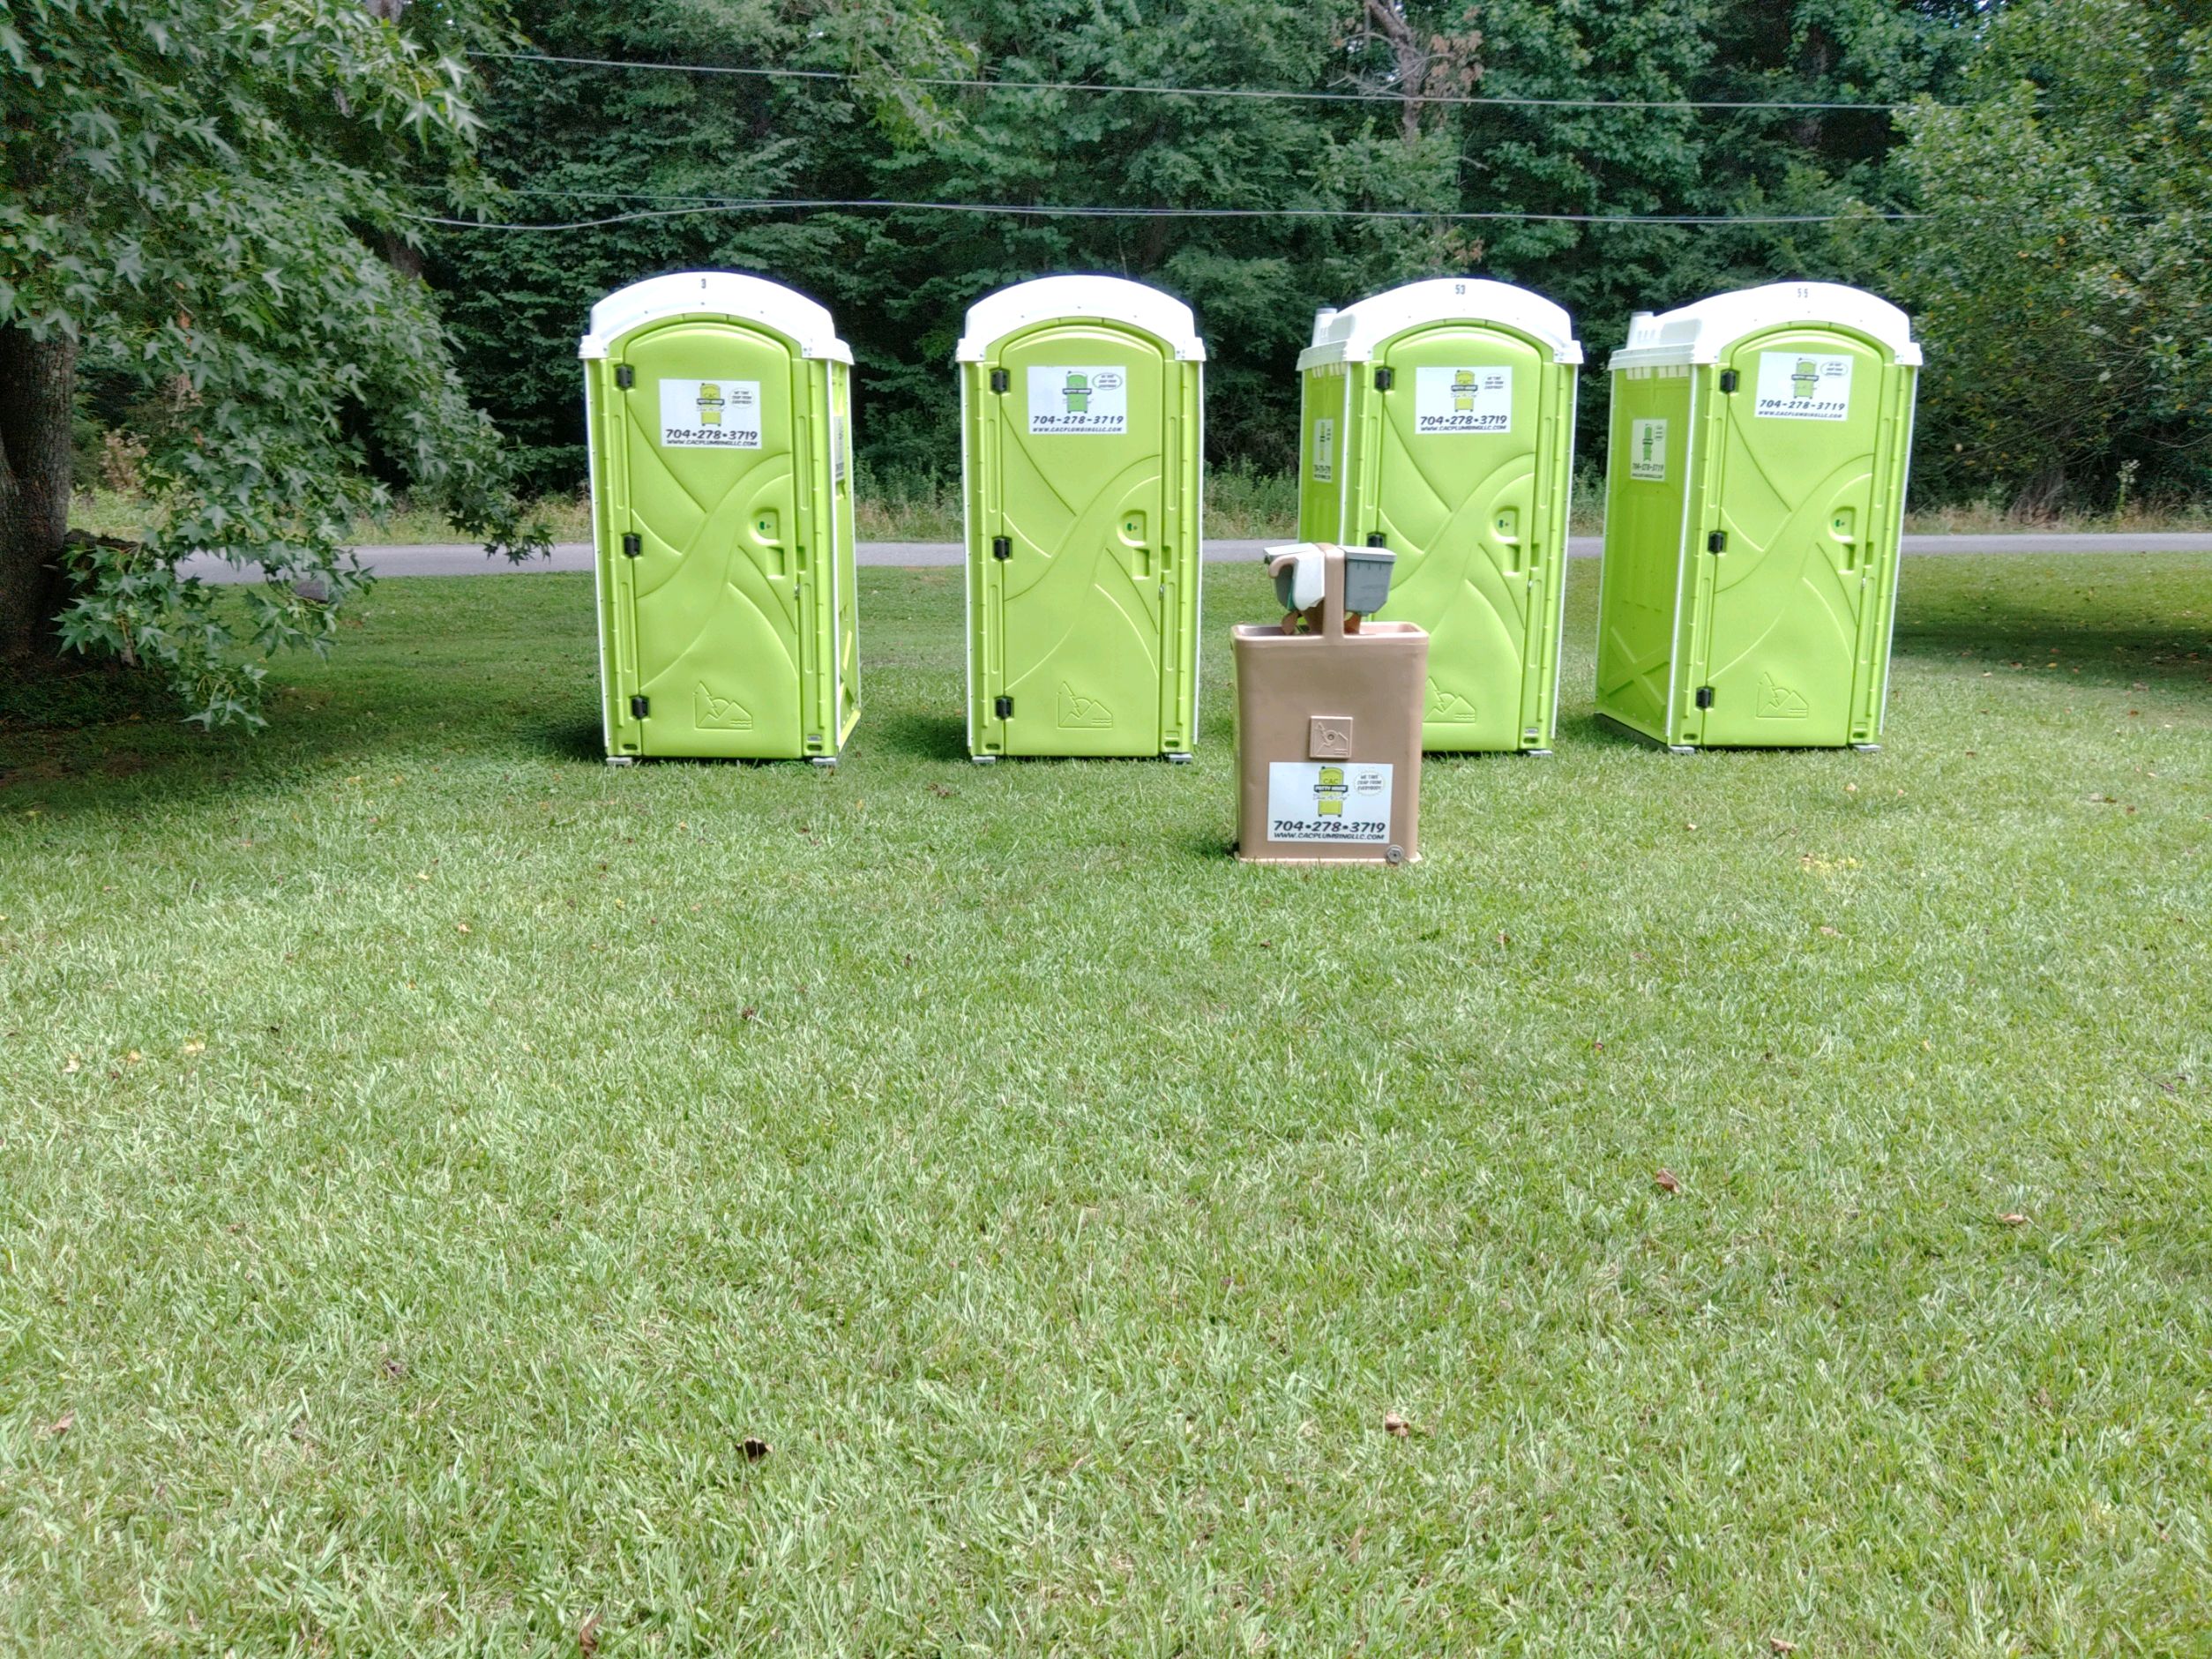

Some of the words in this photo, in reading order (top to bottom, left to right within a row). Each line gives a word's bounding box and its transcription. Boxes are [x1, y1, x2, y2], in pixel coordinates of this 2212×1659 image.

[1455, 284, 1466, 295] 53
[1760, 400, 1845, 411] 704-278-3719
[1033, 415, 1125, 424] 704-278-3719
